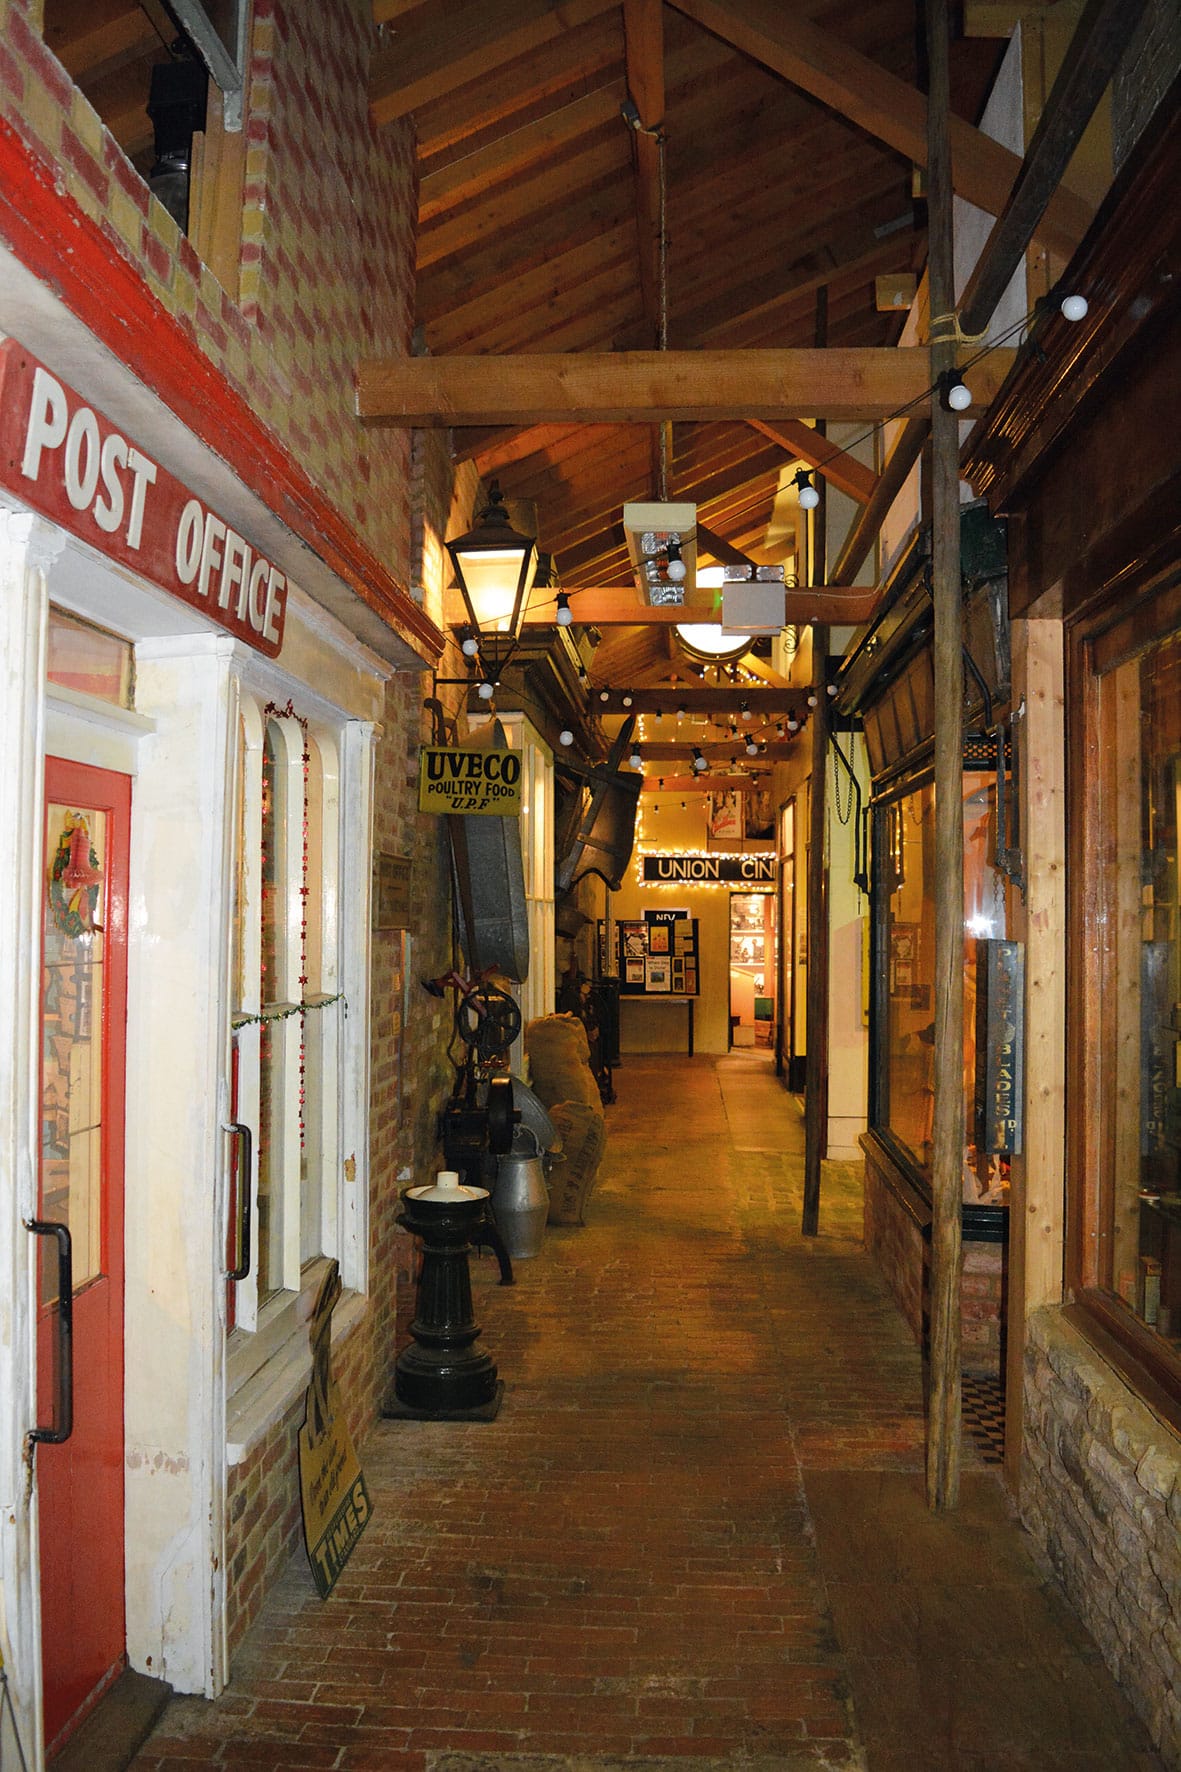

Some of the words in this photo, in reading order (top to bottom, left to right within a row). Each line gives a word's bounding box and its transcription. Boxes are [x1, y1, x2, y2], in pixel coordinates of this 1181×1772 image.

[22, 367, 157, 550] POST
[176, 500, 287, 645] OFFICE
[427, 752, 520, 785] UVECO
[428, 780, 482, 796] POULTRY
[485, 783, 515, 797] FOOD
[658, 860, 719, 878] UNION
[741, 860, 775, 879] CIN
[995, 1043, 1012, 1116] BLADES
[315, 1481, 369, 1586] TIMES
